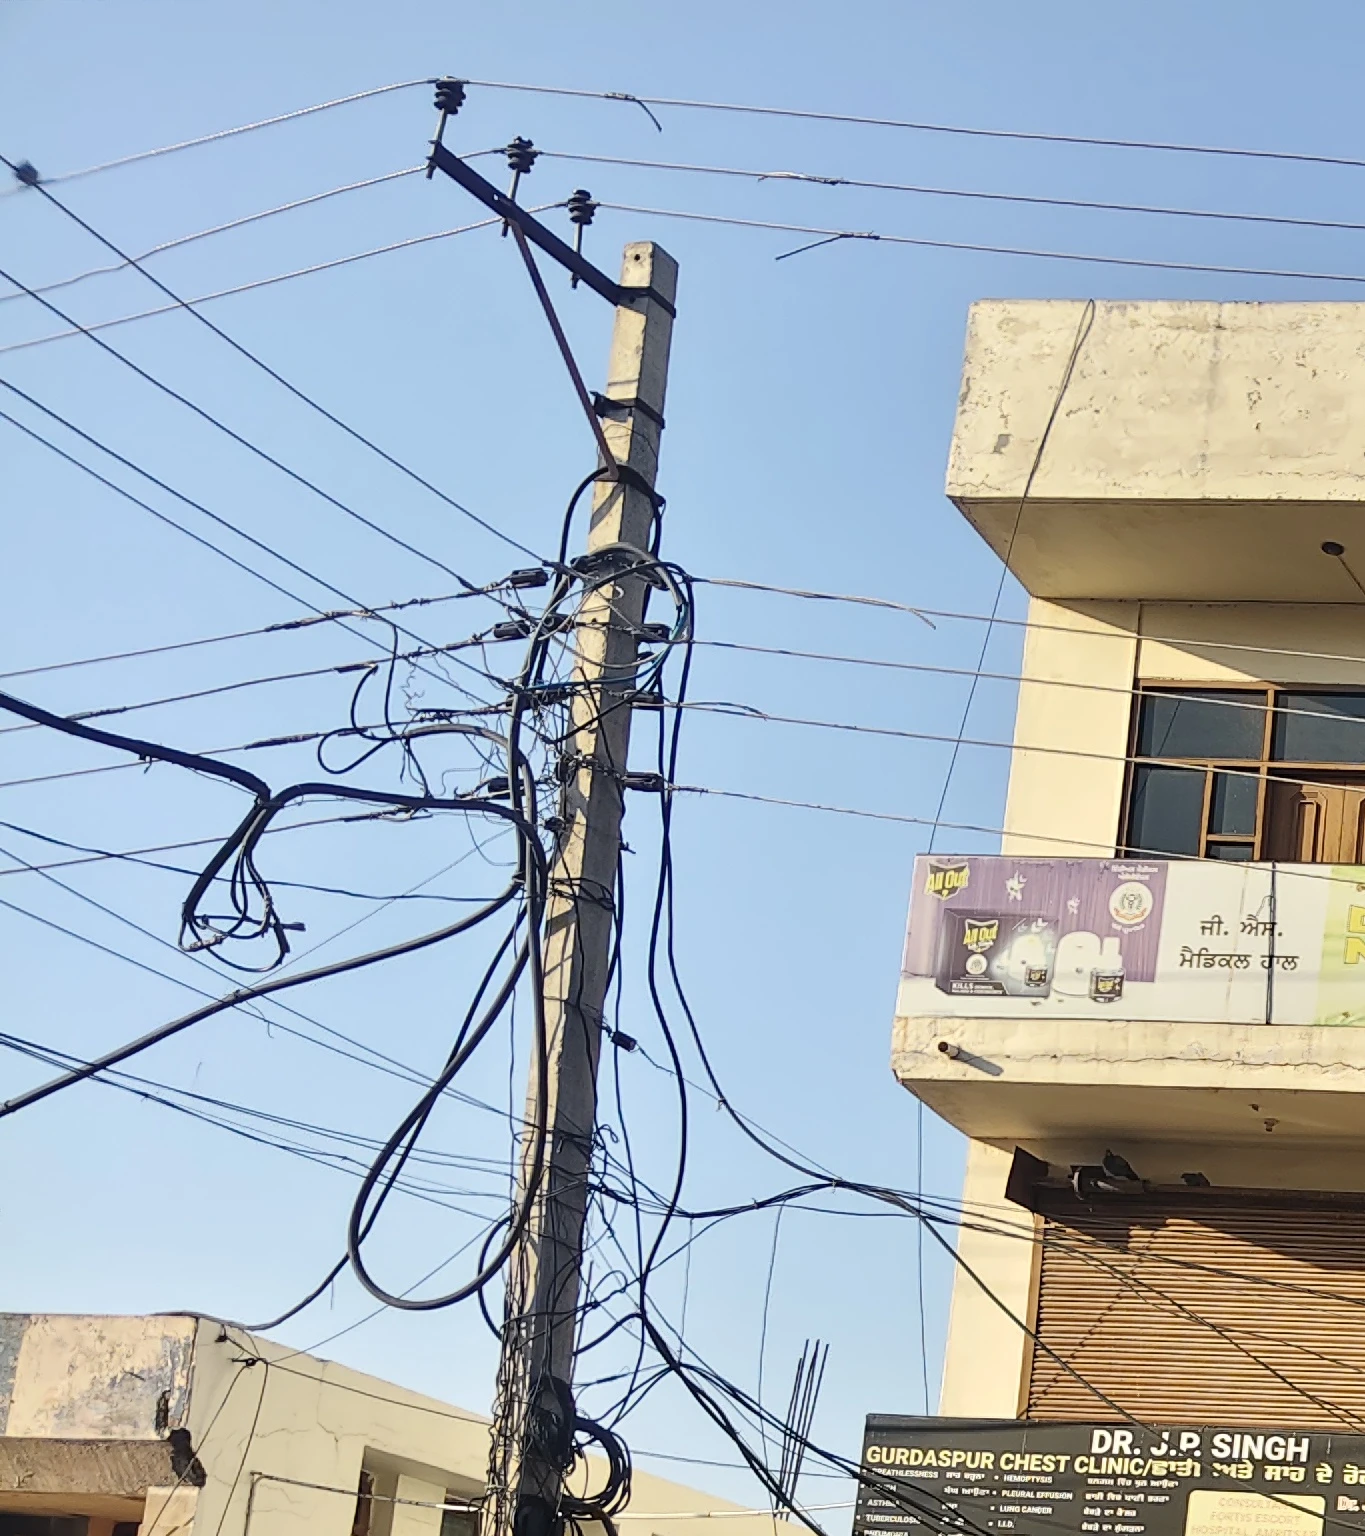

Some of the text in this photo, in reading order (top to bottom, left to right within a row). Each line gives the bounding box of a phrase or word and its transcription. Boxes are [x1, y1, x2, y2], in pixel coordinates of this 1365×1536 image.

[866, 1446, 995, 1470] GURDASPUR
[1000, 1454, 1070, 1473] CHEST
[1091, 1429, 1141, 1456] DR.
[1211, 1433, 1310, 1463] SINGH
